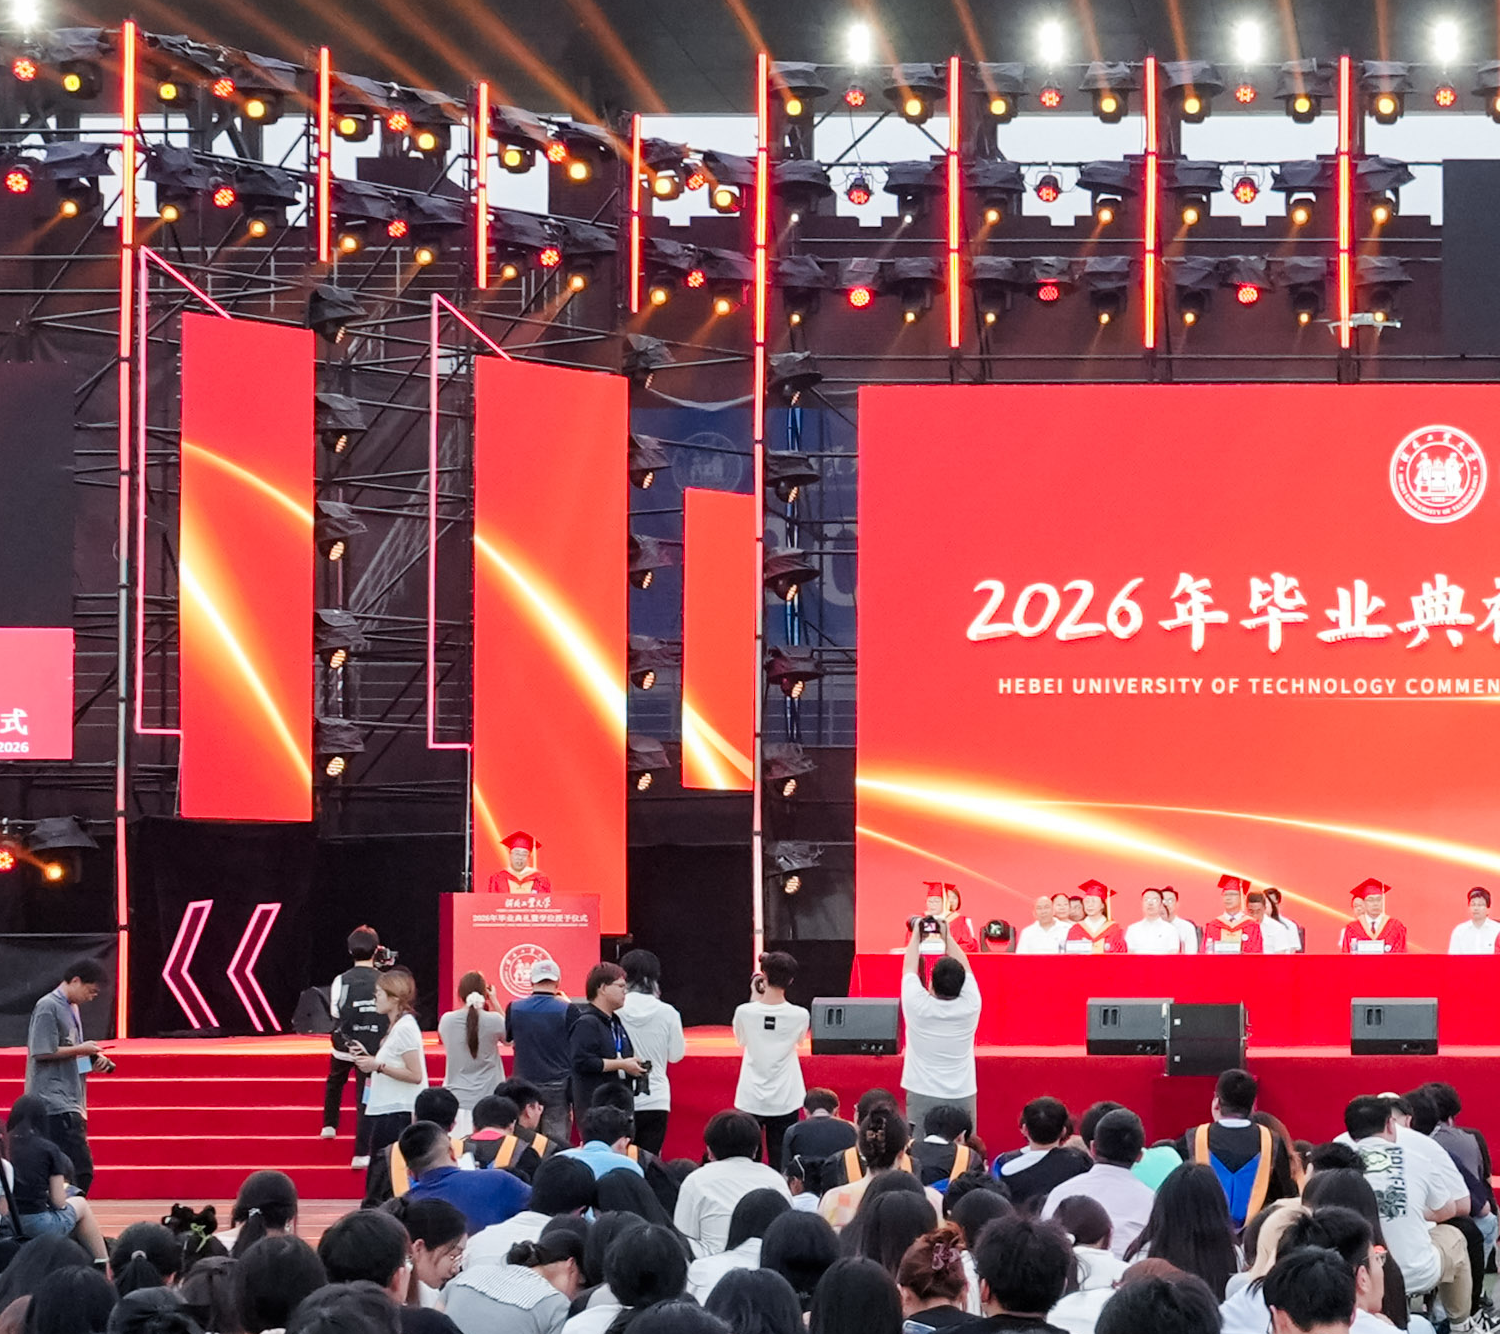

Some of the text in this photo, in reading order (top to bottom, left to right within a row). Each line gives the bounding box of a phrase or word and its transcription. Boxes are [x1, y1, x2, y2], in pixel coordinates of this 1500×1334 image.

[998, 677, 1063, 694] HEBEI
[1072, 677, 1203, 694] UNIVERSITY
[1211, 677, 1240, 695] OF
[1248, 677, 1396, 695] TECHNOLOGY
